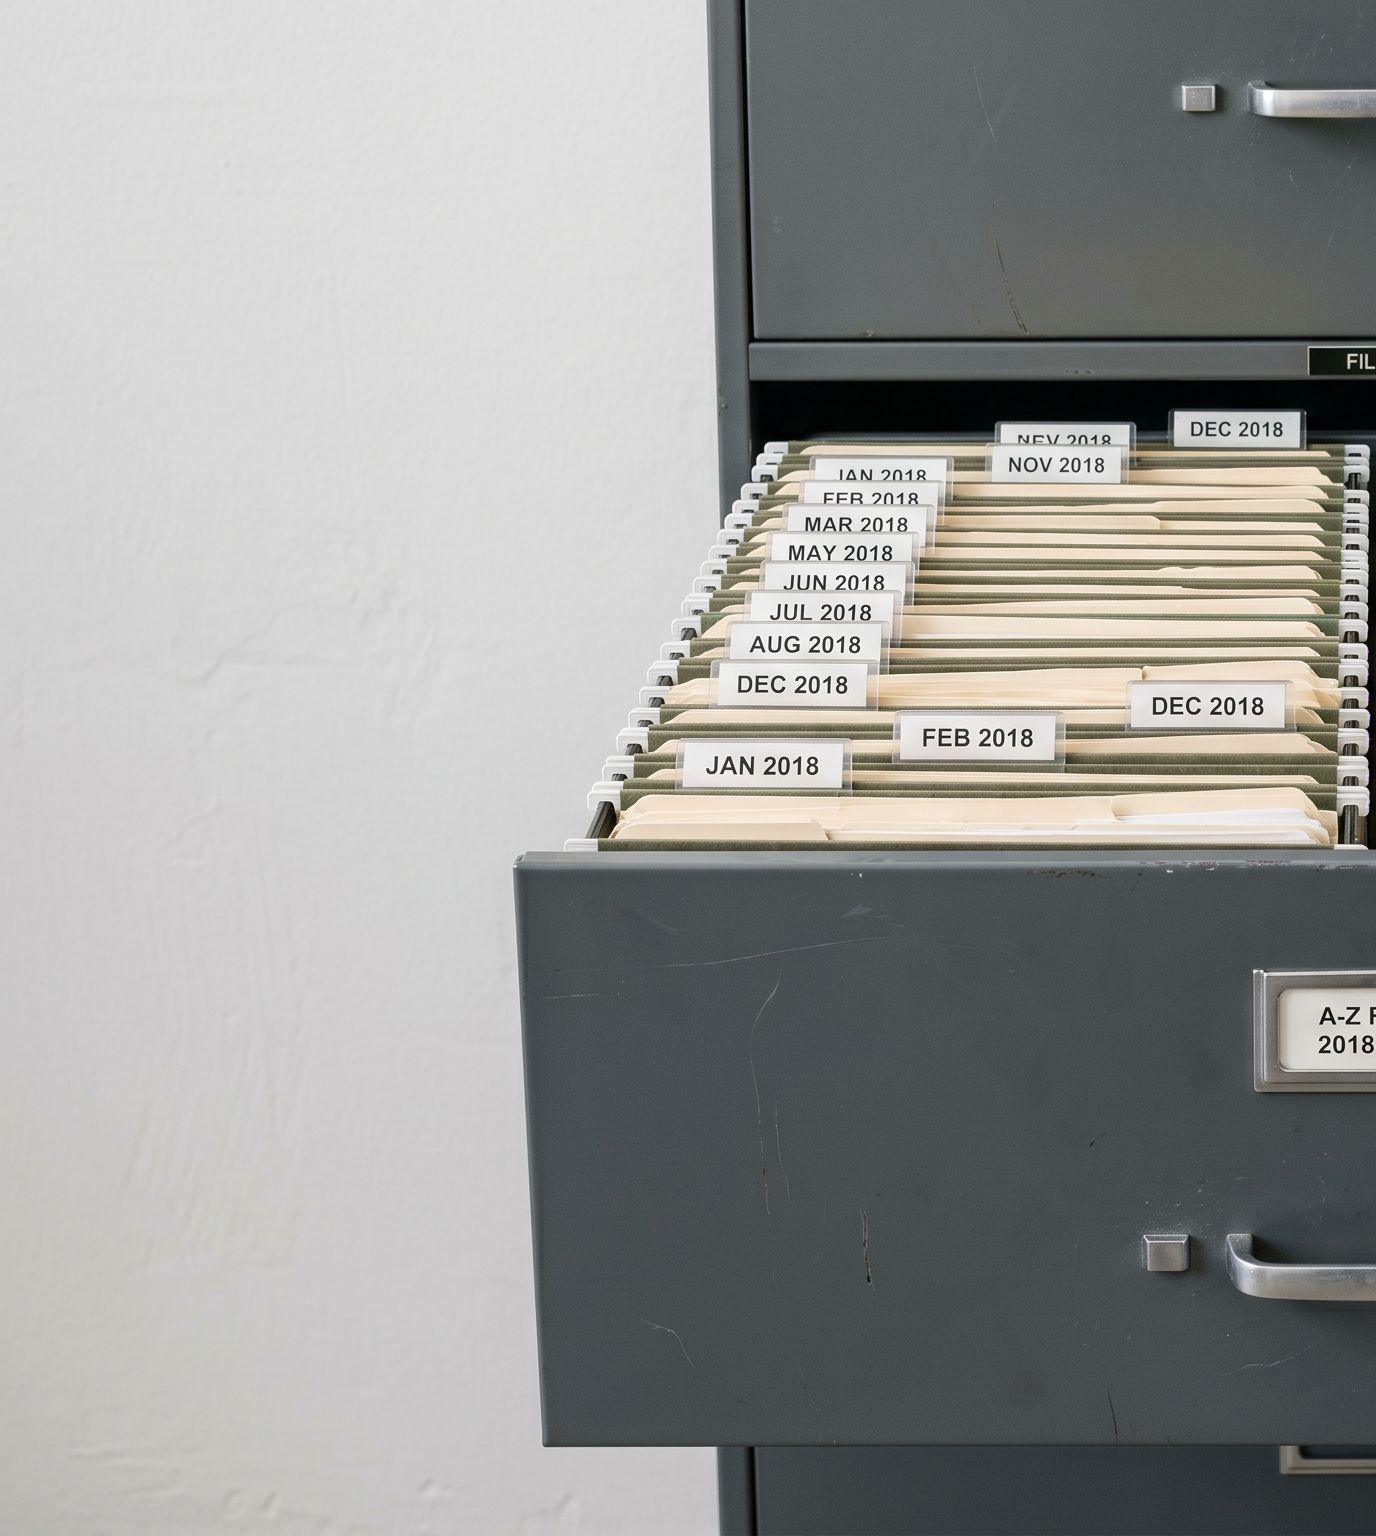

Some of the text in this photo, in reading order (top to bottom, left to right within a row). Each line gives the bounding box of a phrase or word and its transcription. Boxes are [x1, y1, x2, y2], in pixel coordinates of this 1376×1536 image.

[1191, 422, 1283, 437] DEC 2018
[1067, 435, 1111, 444] 2018
[1009, 457, 1104, 473] NOV 2018
[881, 470, 926, 480] 2018
[872, 493, 918, 504] 2018
[805, 517, 907, 531] MAR 2018
[789, 545, 892, 560] MAY 2018
[784, 575, 884, 590] JUN 2018
[770, 604, 871, 620] JUL 2018
[750, 636, 860, 653] AUG 2018
[738, 675, 847, 694] DEC 2018
[1153, 697, 1264, 715] DEC 2018
[923, 729, 1033, 747] FEB 2018
[706, 756, 818, 775] JAN 2018
[1319, 1007, 1361, 1025] A-Z
